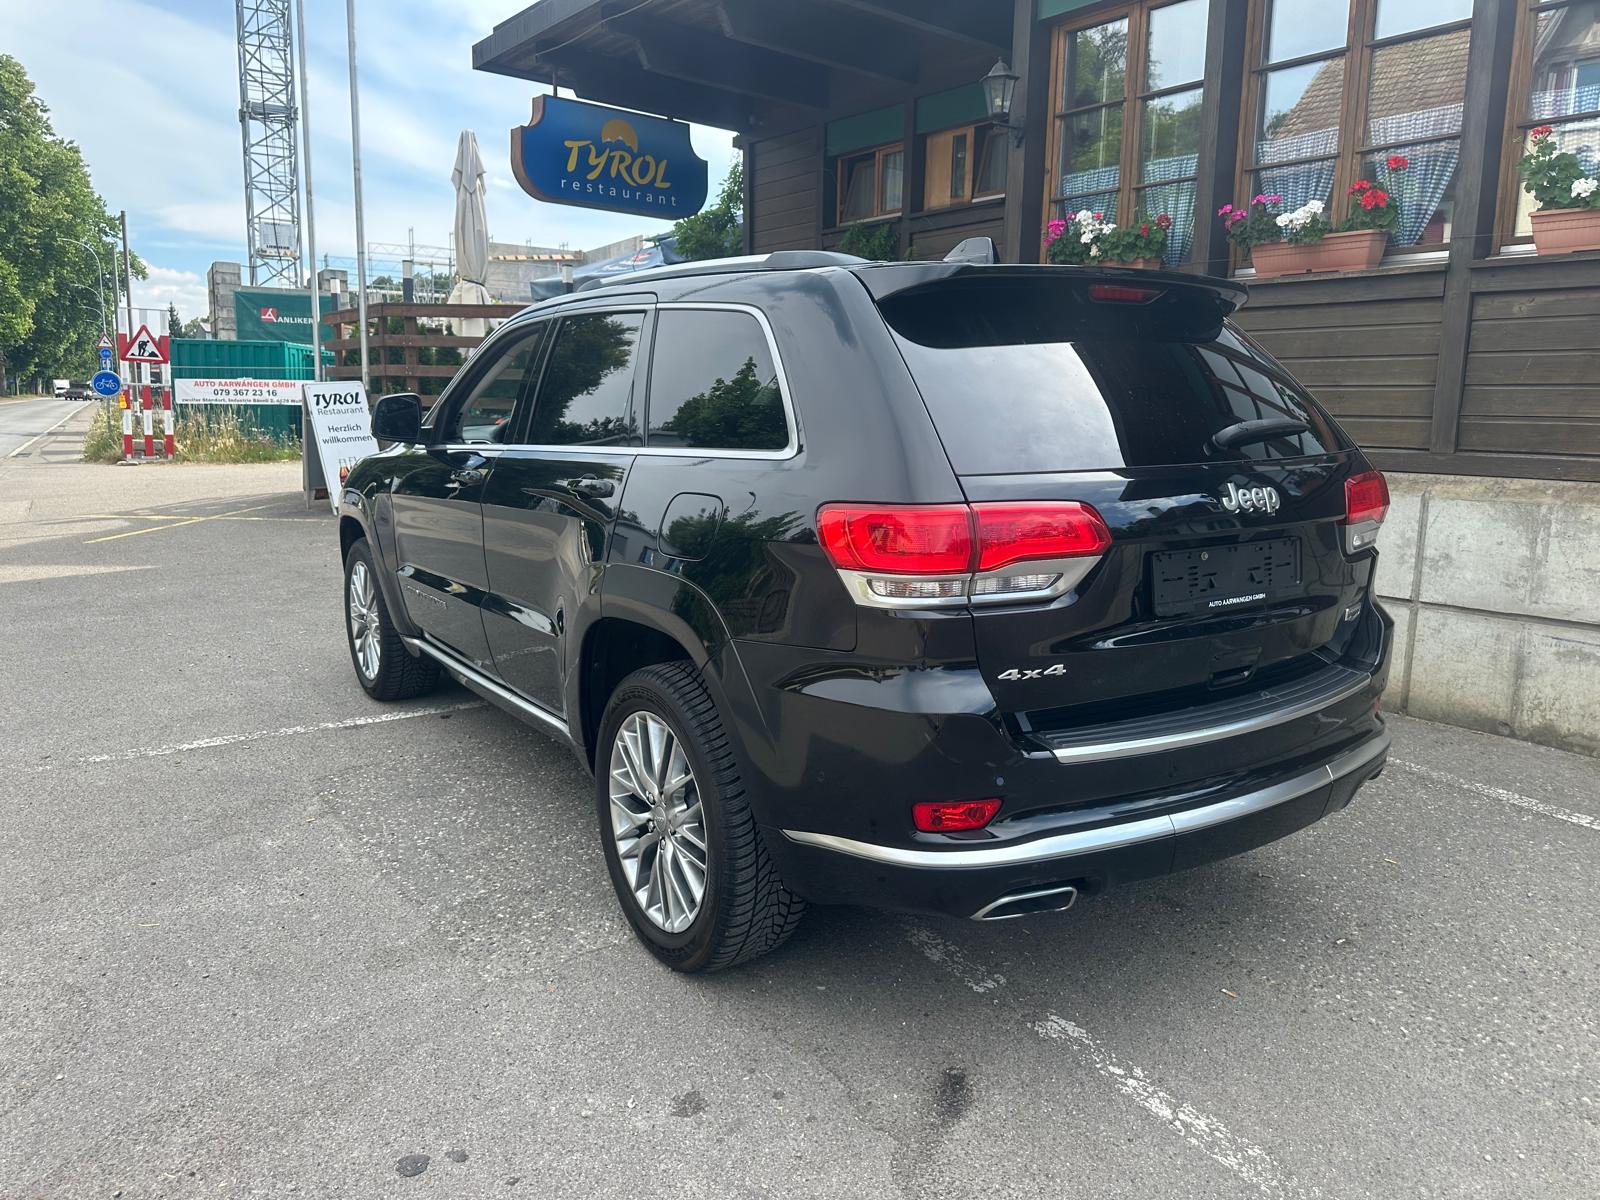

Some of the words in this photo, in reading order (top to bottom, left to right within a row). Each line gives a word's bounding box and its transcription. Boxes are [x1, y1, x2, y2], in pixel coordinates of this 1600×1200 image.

[564, 140, 672, 188] TYROL
[561, 178, 677, 206] restaurant
[277, 316, 313, 324] ANLIKER
[213, 389, 231, 397] 079
[233, 389, 250, 397] 367
[252, 389, 263, 397] 23
[267, 389, 277, 397] 16
[313, 392, 361, 409] TYROL
[317, 407, 364, 416] Restaurant
[328, 424, 362, 433] Herzlich
[322, 434, 372, 444] willkommen
[1222, 482, 1280, 514] Jeep
